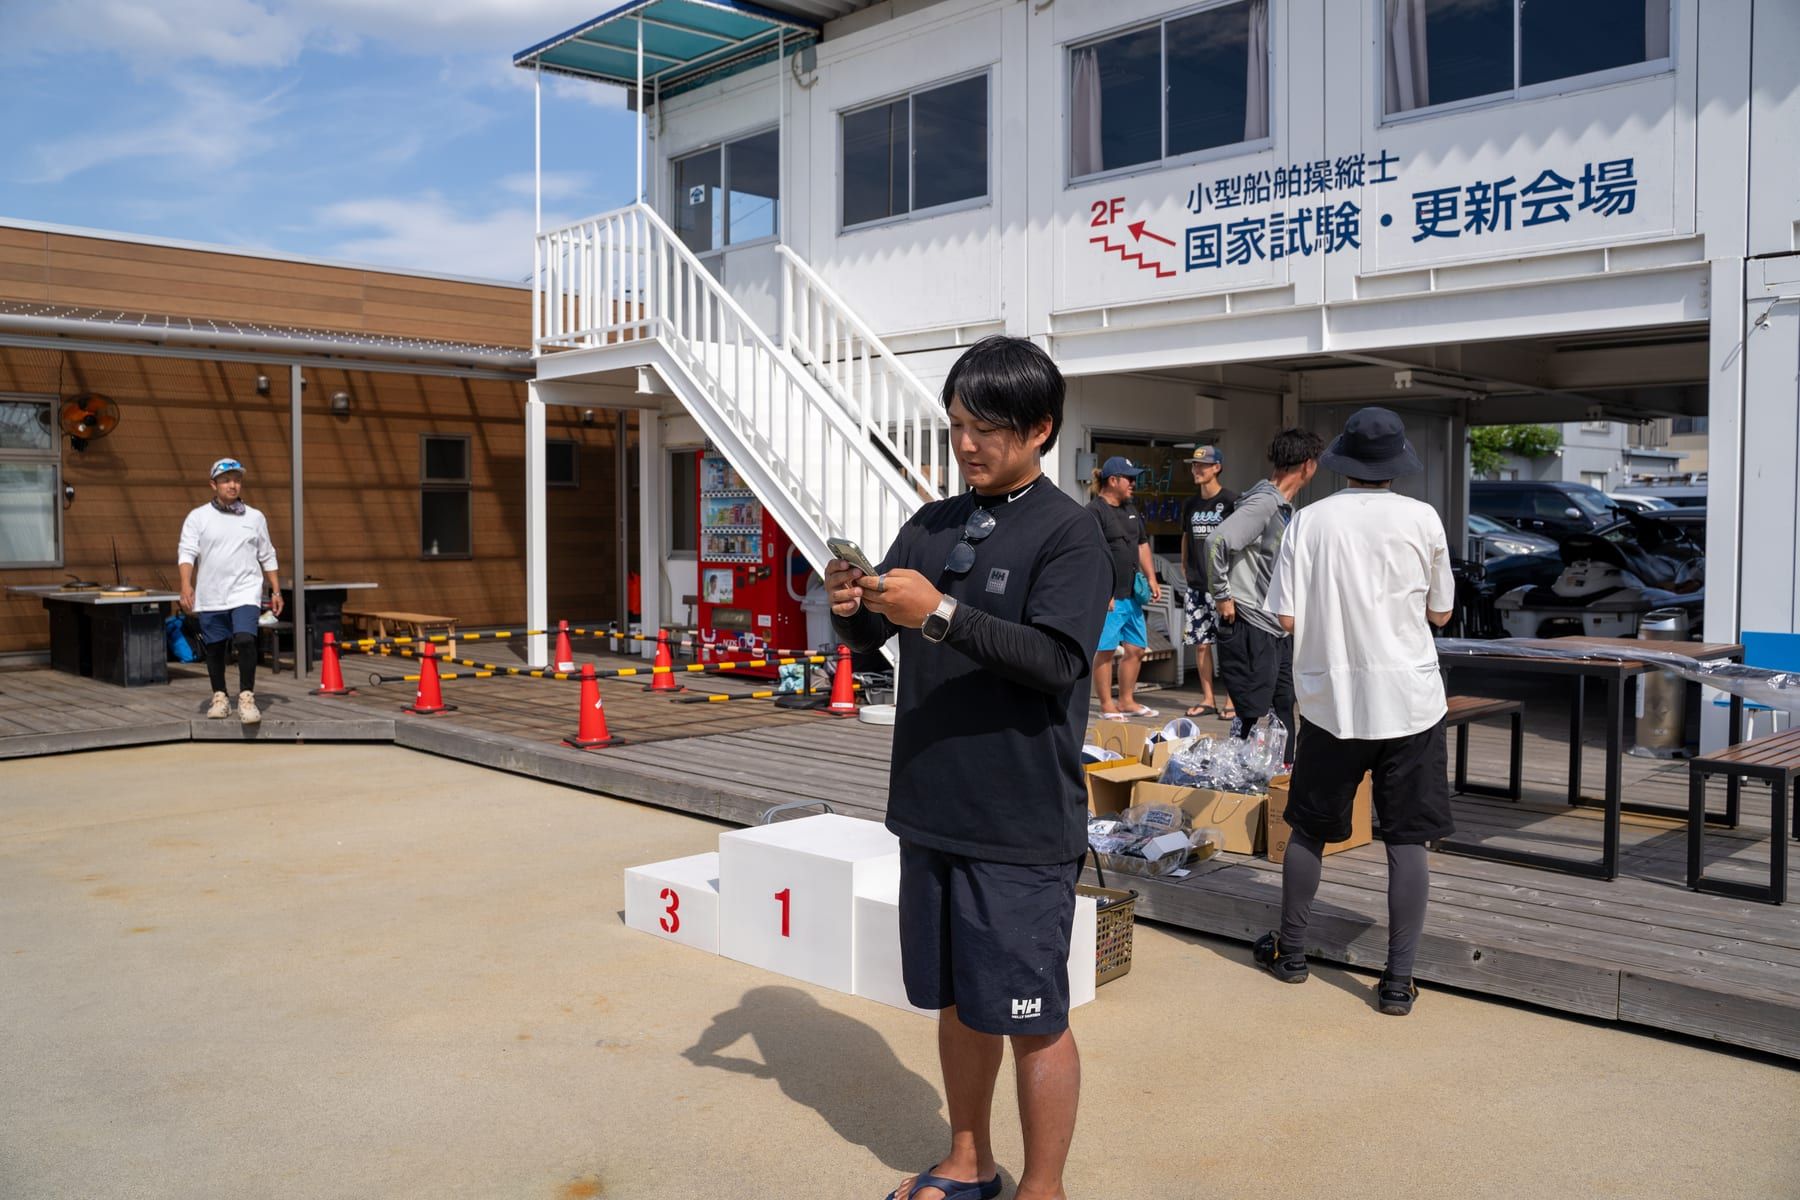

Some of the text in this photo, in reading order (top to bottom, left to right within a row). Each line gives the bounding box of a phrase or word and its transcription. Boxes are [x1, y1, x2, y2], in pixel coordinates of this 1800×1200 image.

[1187, 150, 1400, 214] 小型船舶操縦士
[1091, 196, 1126, 227] 2F
[1185, 158, 1637, 273] 国家試験・更新会場
[659, 888, 680, 933] 3
[774, 888, 790, 937] 1
[1012, 998, 1041, 1015] HH
